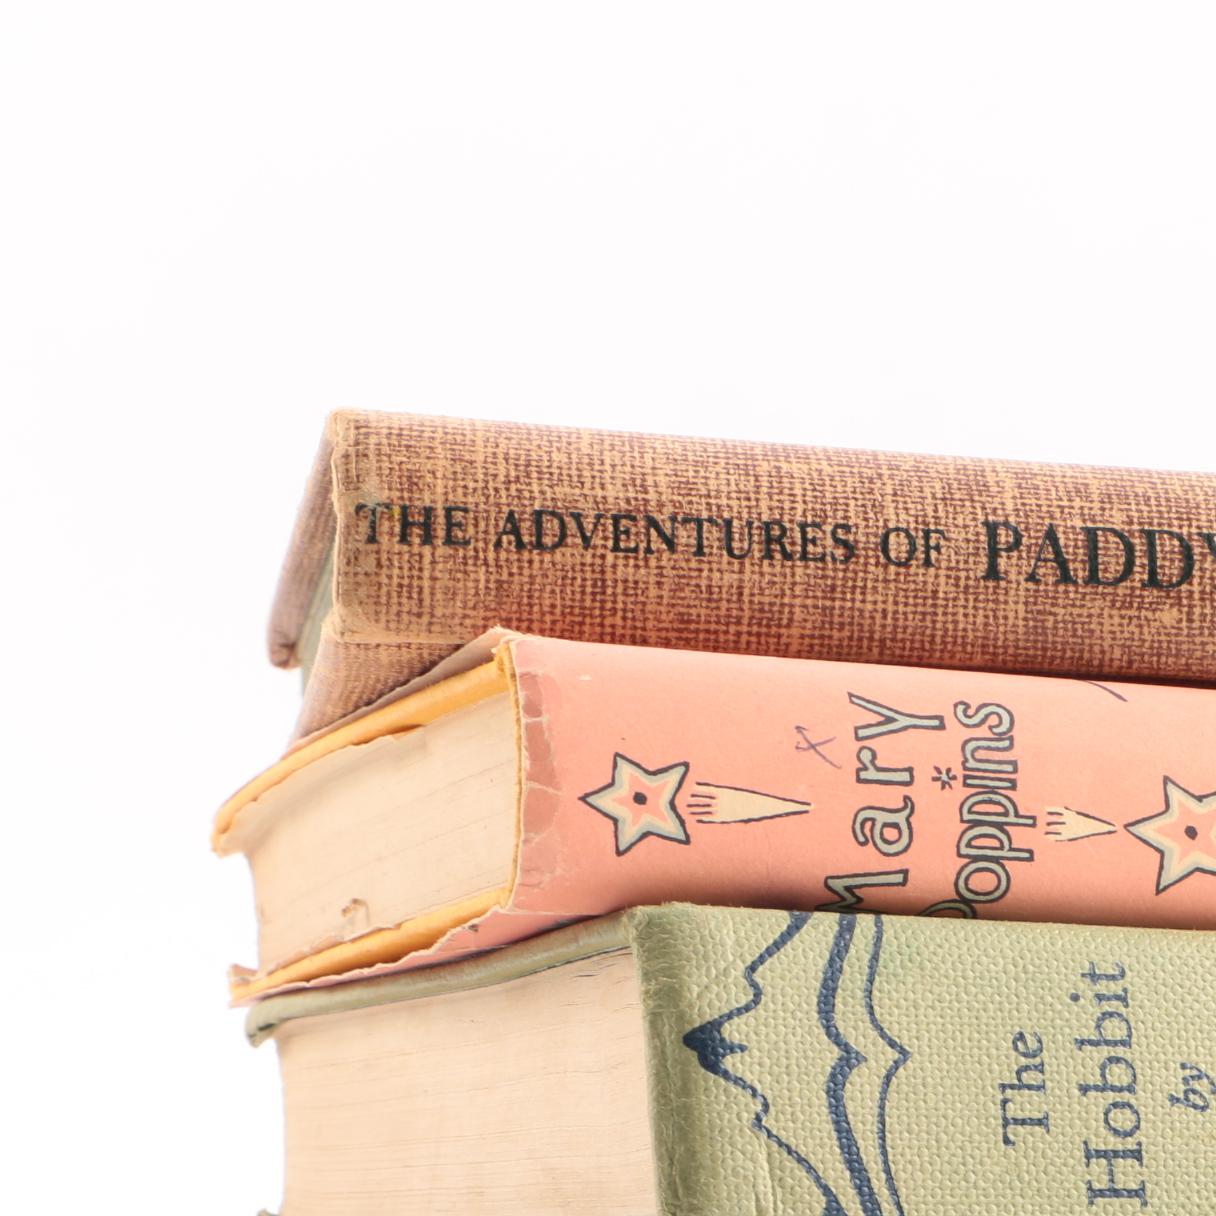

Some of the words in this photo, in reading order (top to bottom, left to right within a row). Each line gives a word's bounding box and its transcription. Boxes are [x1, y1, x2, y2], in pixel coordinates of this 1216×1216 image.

[354, 502, 472, 548] THE
[493, 508, 855, 565] ADVENTURES
[880, 526, 946, 568] OF
[998, 1029, 1050, 1147] The
[1068, 960, 1148, 1208] Hobbit
[1168, 1062, 1216, 1113] by
